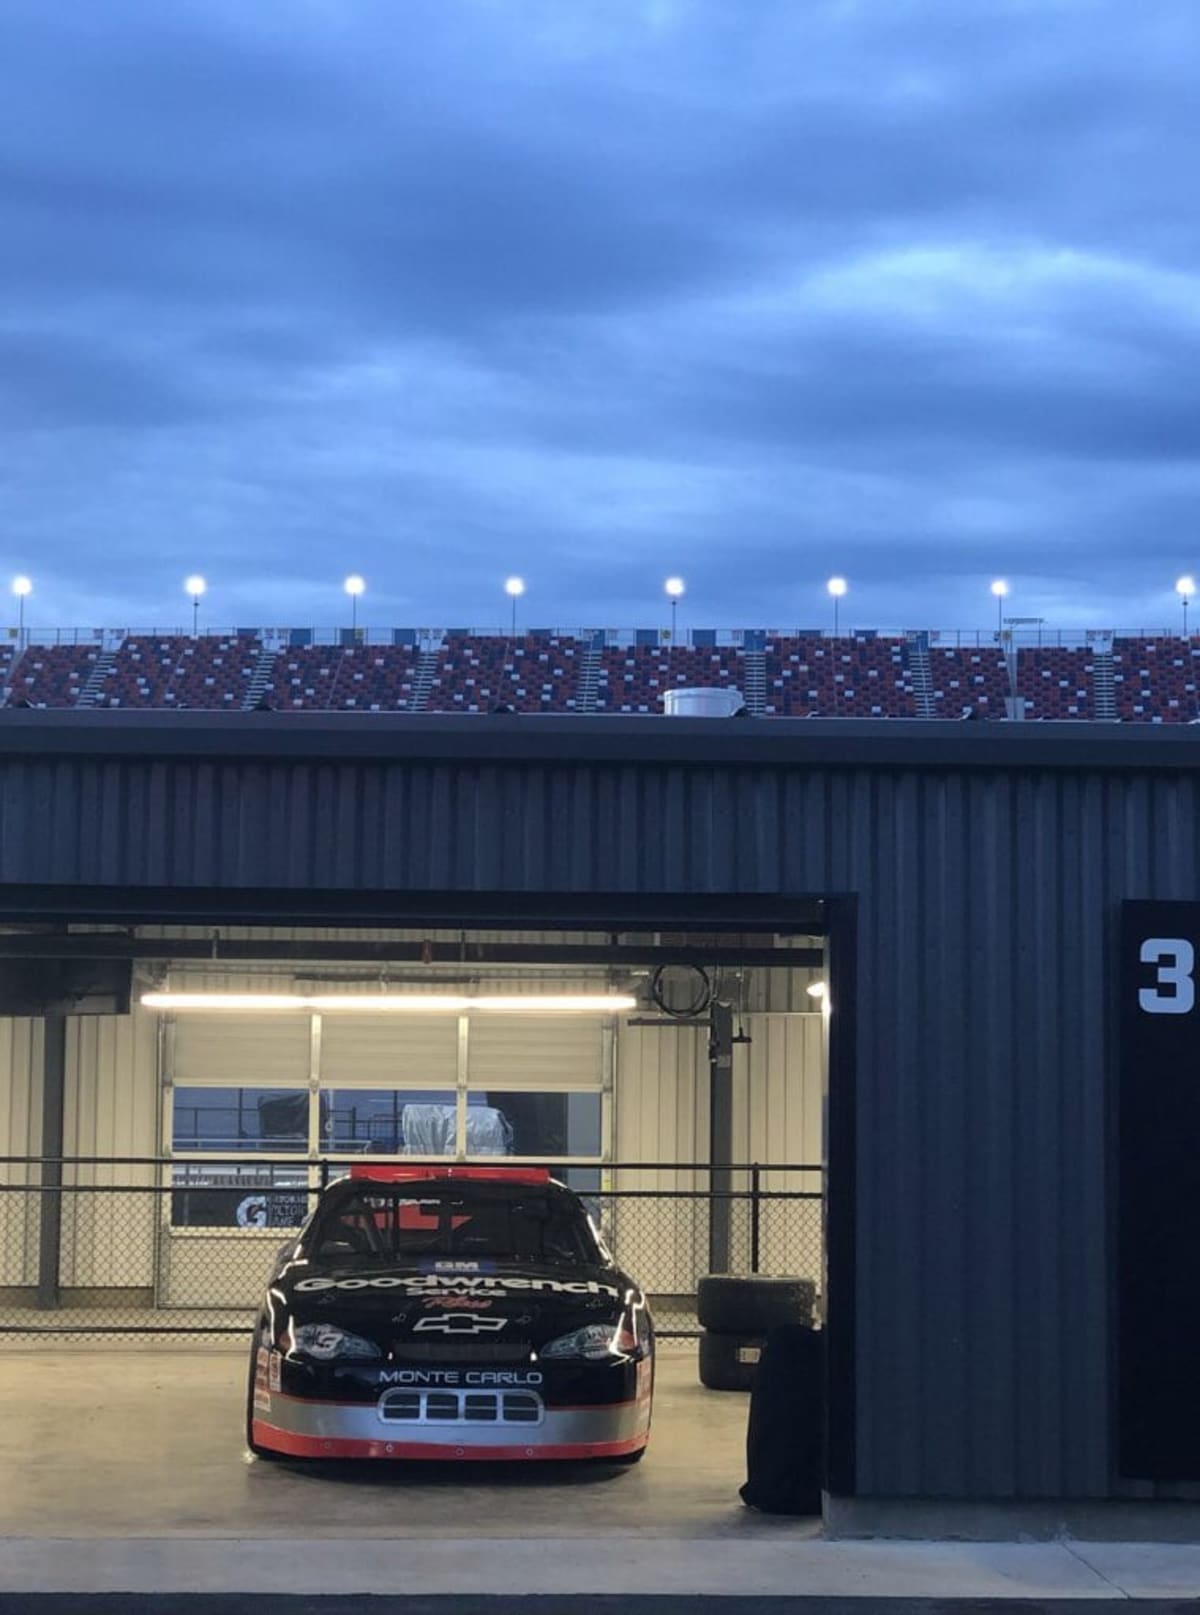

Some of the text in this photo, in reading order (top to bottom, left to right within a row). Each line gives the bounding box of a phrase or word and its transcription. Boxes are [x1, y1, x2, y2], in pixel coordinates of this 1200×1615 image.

[1138, 937, 1195, 1014] 3
[293, 1274, 620, 1297] Goodwrench
[405, 1287, 507, 1297] Service
[379, 1370, 543, 1384] MONTE CARLO
